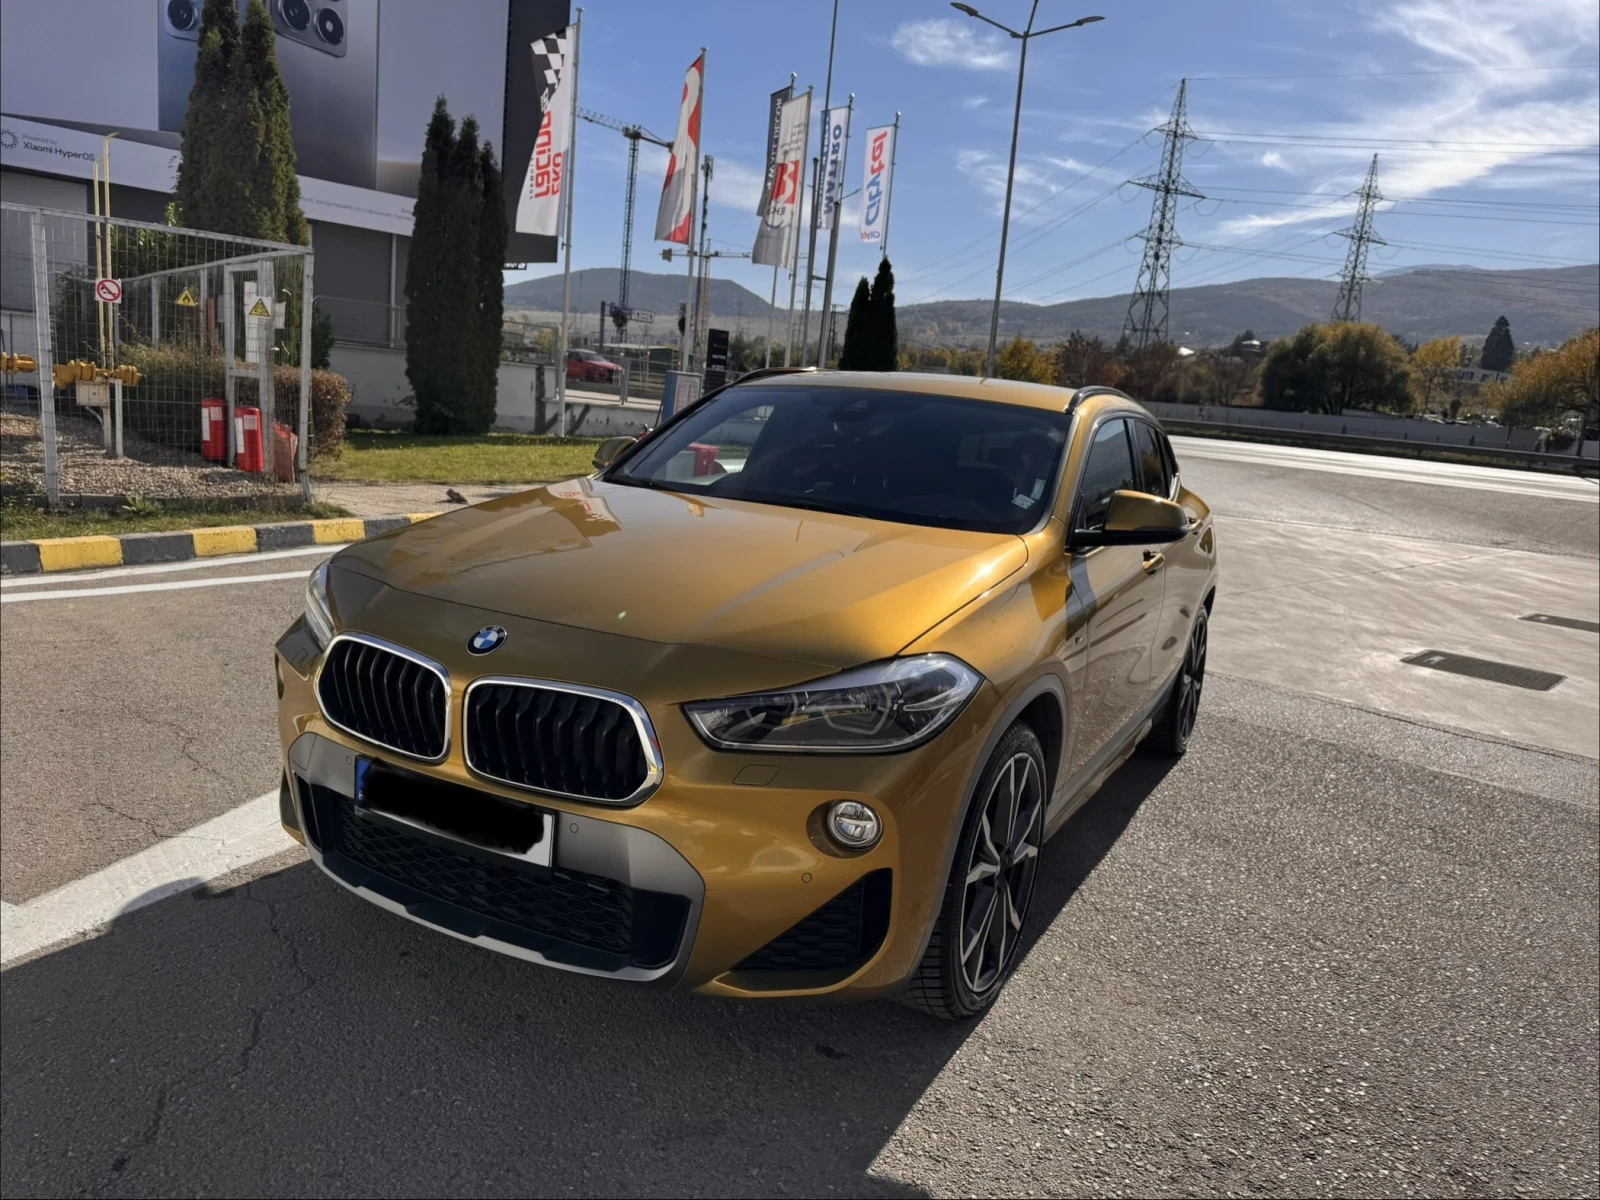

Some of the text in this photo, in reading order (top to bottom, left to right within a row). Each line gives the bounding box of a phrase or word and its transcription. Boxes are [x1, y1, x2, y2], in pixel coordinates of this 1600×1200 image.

[22, 134, 48, 144] Powered
[23, 141, 95, 161] Xiaomi HyperOS
